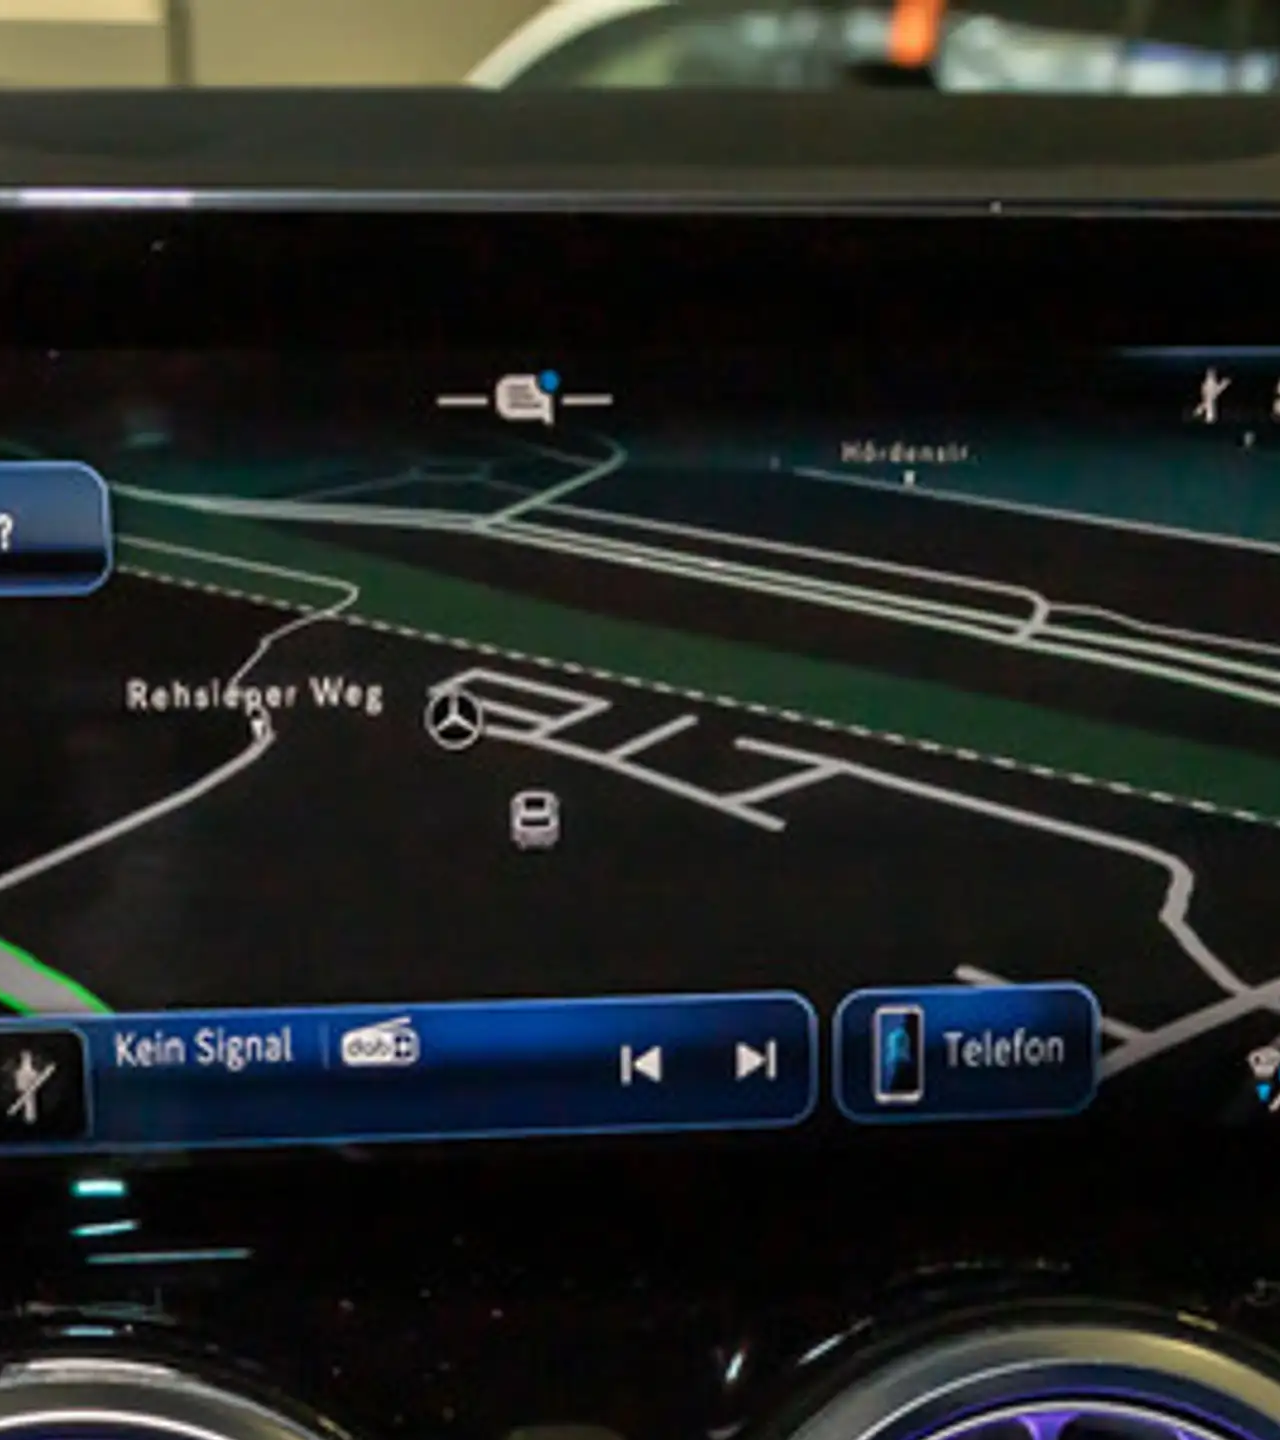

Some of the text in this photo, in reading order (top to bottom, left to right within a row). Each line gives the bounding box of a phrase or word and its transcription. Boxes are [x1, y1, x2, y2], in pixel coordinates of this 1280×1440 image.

[308, 675, 385, 718] Weg
[114, 1028, 294, 1073] Kein Signal
[943, 1028, 1066, 1070] Telefon
